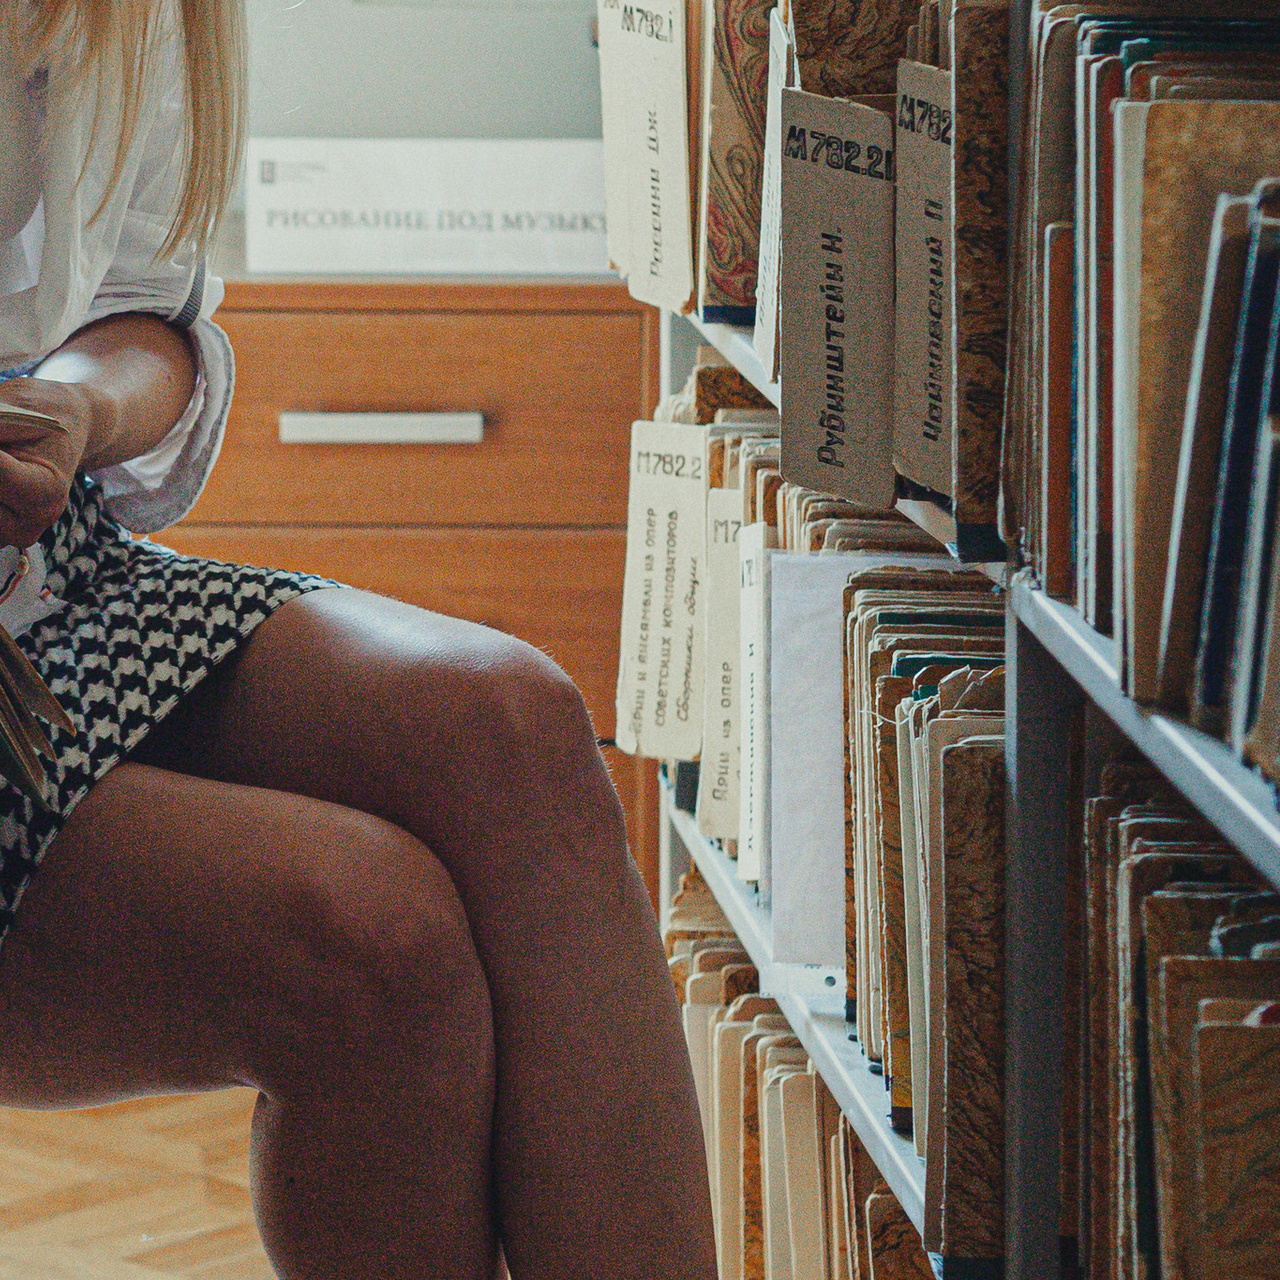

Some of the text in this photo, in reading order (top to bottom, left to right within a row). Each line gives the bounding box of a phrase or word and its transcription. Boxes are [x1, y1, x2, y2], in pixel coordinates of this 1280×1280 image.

[266, 208, 430, 230] РИСОВАНИЕ
[437, 209, 493, 232] ПОД
[817, 226, 849, 467] Рубинштейн Н.
[922, 235, 945, 441] Чайковский
